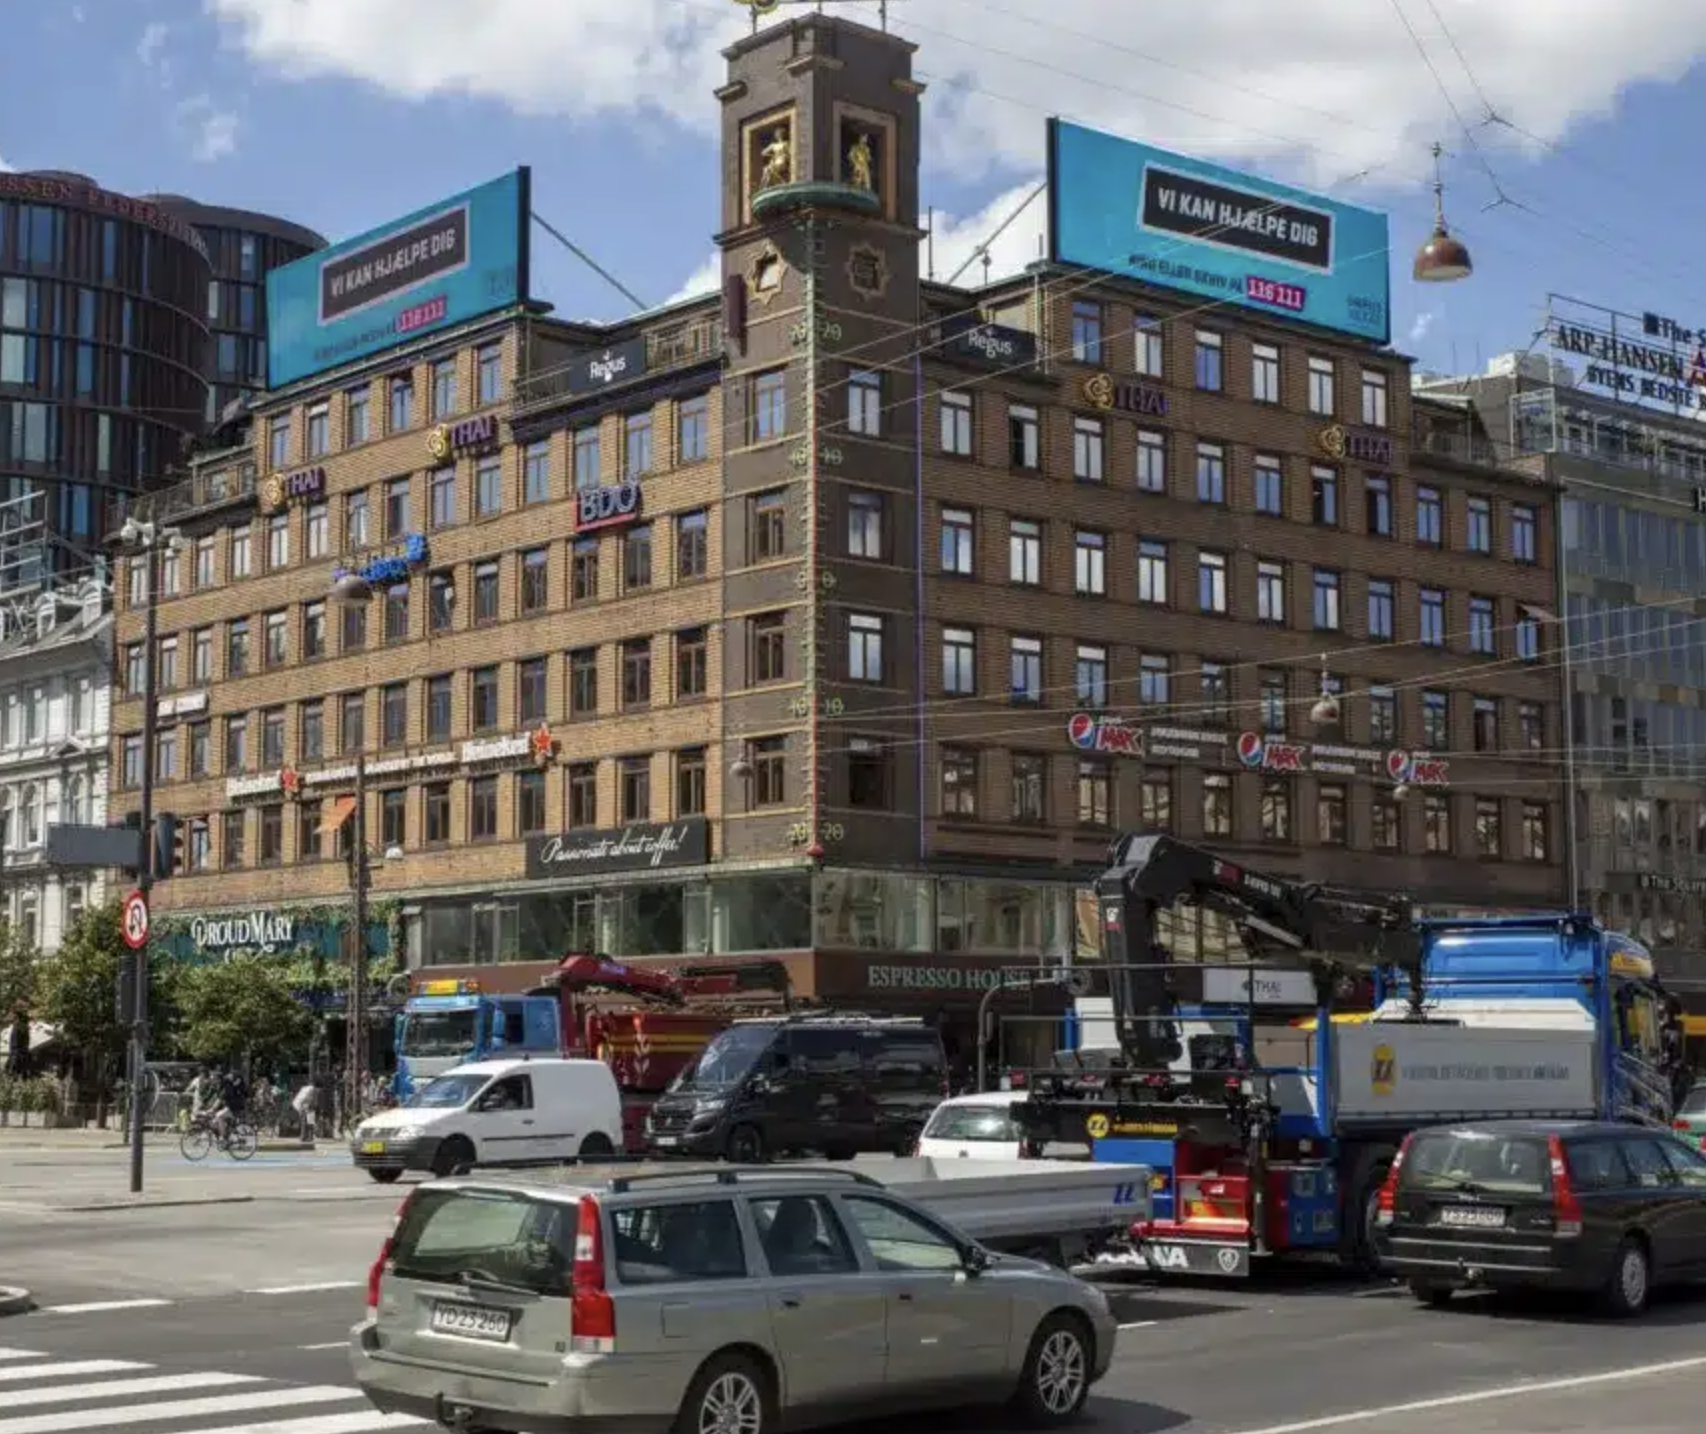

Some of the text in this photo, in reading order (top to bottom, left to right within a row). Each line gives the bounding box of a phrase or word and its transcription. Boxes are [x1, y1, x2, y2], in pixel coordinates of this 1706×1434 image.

[1158, 187, 1318, 247] VI KAN HJÆLPE DIG
[330, 228, 457, 297] VI KAN HJÆLPE DIG
[1276, 283, 1304, 309] 111
[968, 329, 1013, 359] Regus
[1660, 317, 1692, 345] The
[589, 354, 626, 382] Regus
[452, 415, 496, 447] THAI
[287, 467, 323, 497] THAI
[579, 481, 636, 523] BDO
[251, 911, 294, 952] MARY
[867, 966, 961, 989] ESPRESSO
